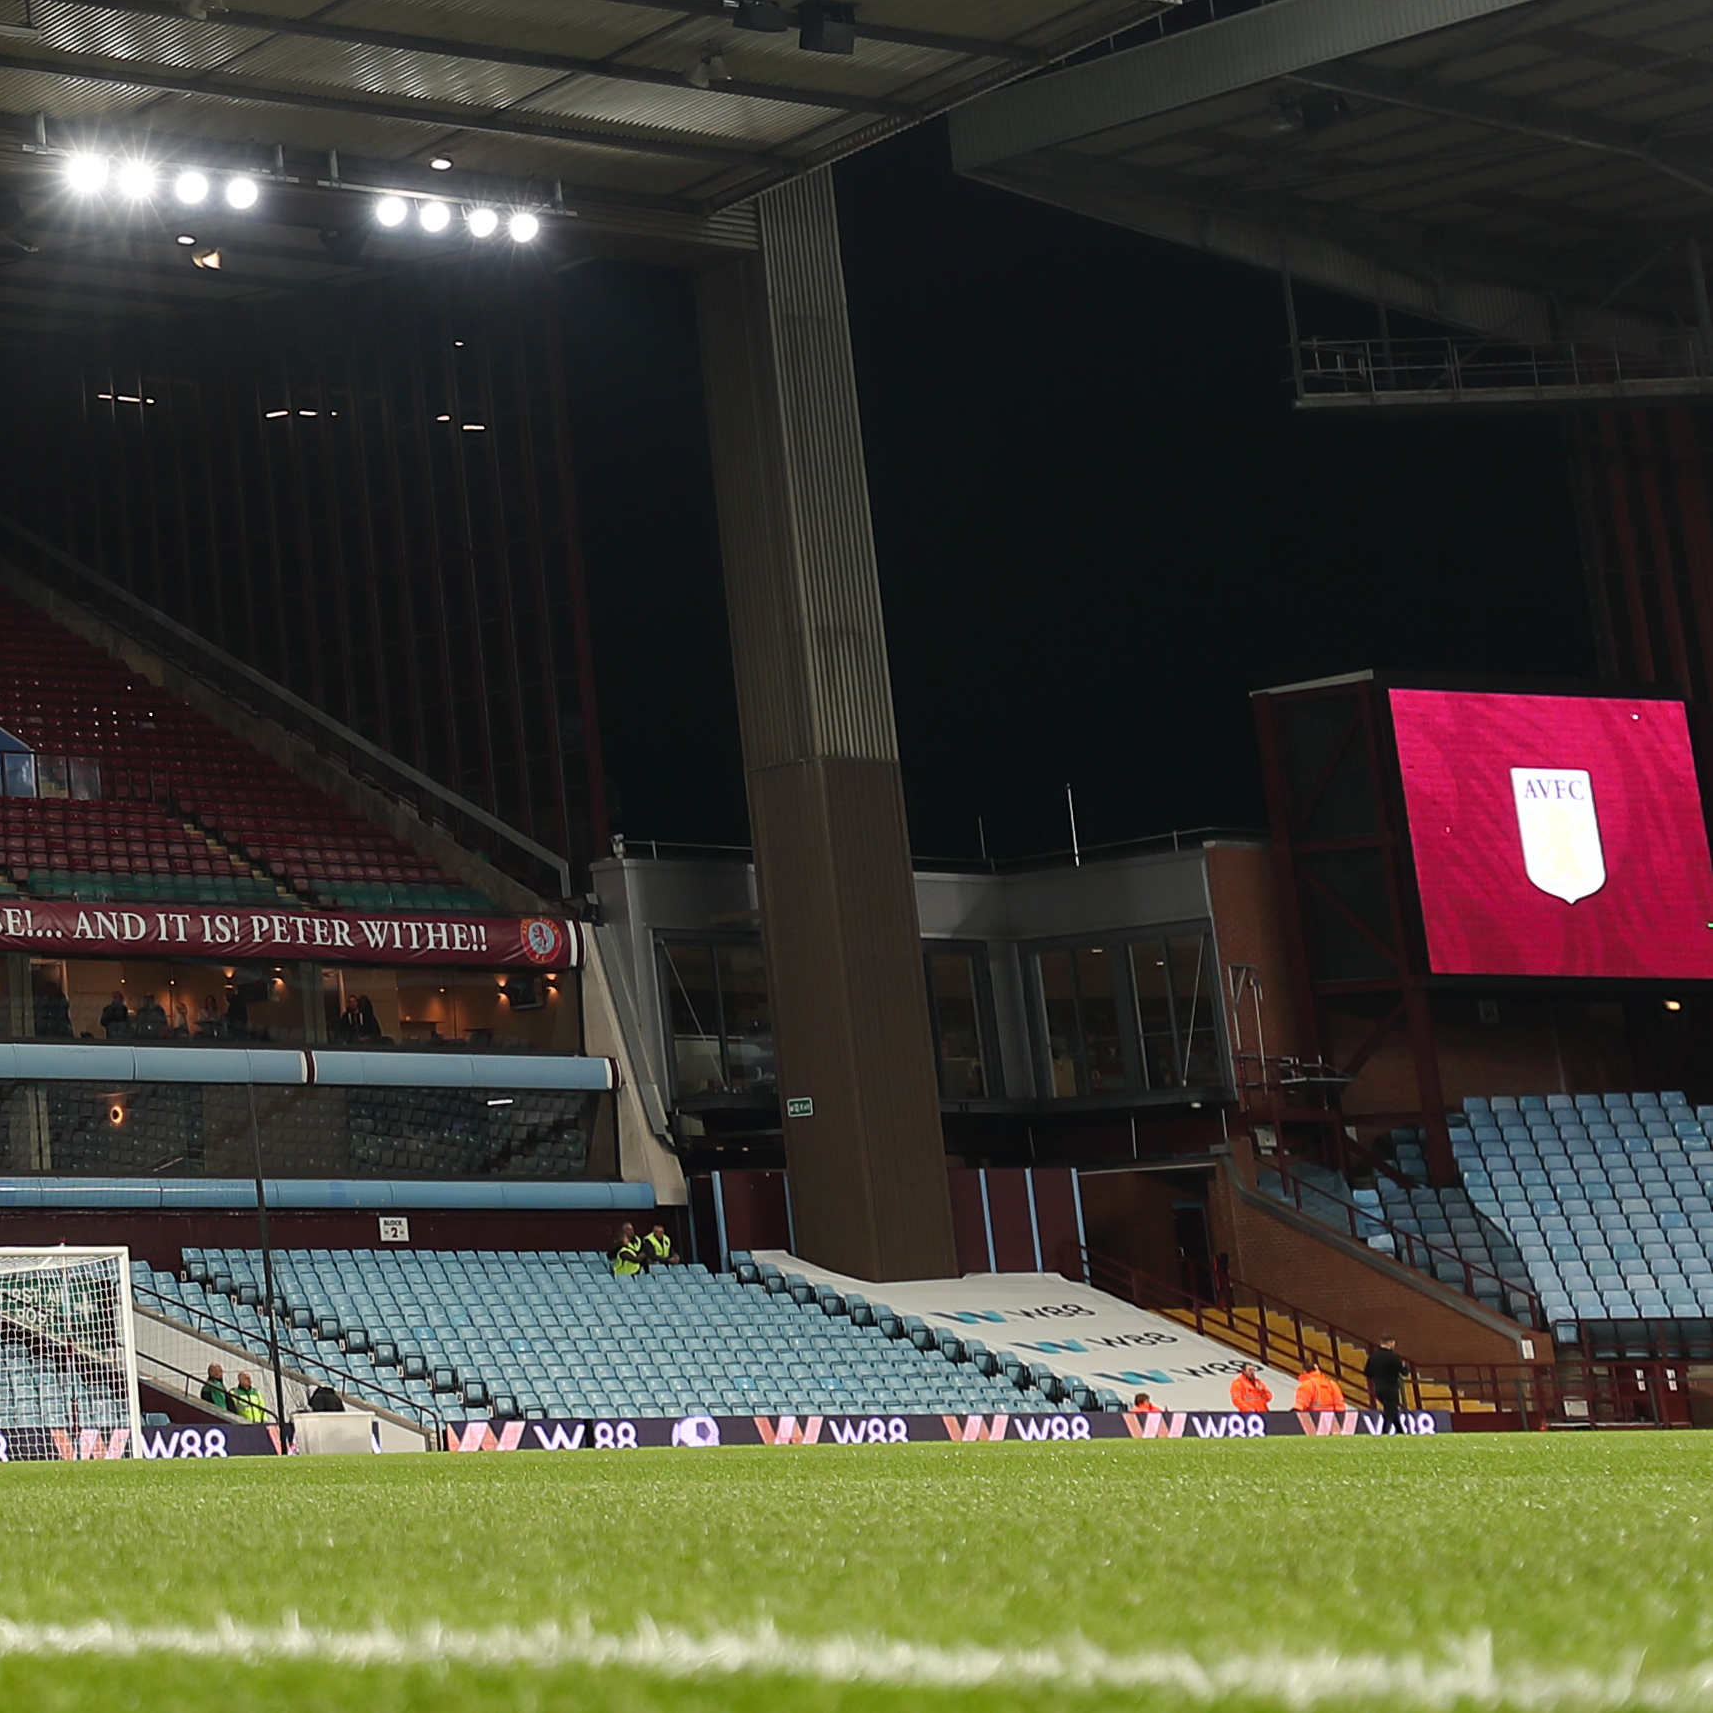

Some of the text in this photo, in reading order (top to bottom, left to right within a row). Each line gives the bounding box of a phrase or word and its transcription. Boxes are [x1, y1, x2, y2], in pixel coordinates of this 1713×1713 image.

[1523, 778, 1586, 801] AVFC
[73, 912, 146, 940] AND
[156, 914, 190, 941] IT
[200, 915, 239, 942] IS!
[250, 916, 354, 946] PETER
[358, 921, 486, 951] WITHE!!
[390, 1227, 399, 1238] 2
[533, 1421, 637, 1450] W88
[829, 1417, 909, 1444] W88
[1014, 1414, 1091, 1441] W88
[1192, 1412, 1266, 1438] W88
[138, 1429, 227, 1459] W88
